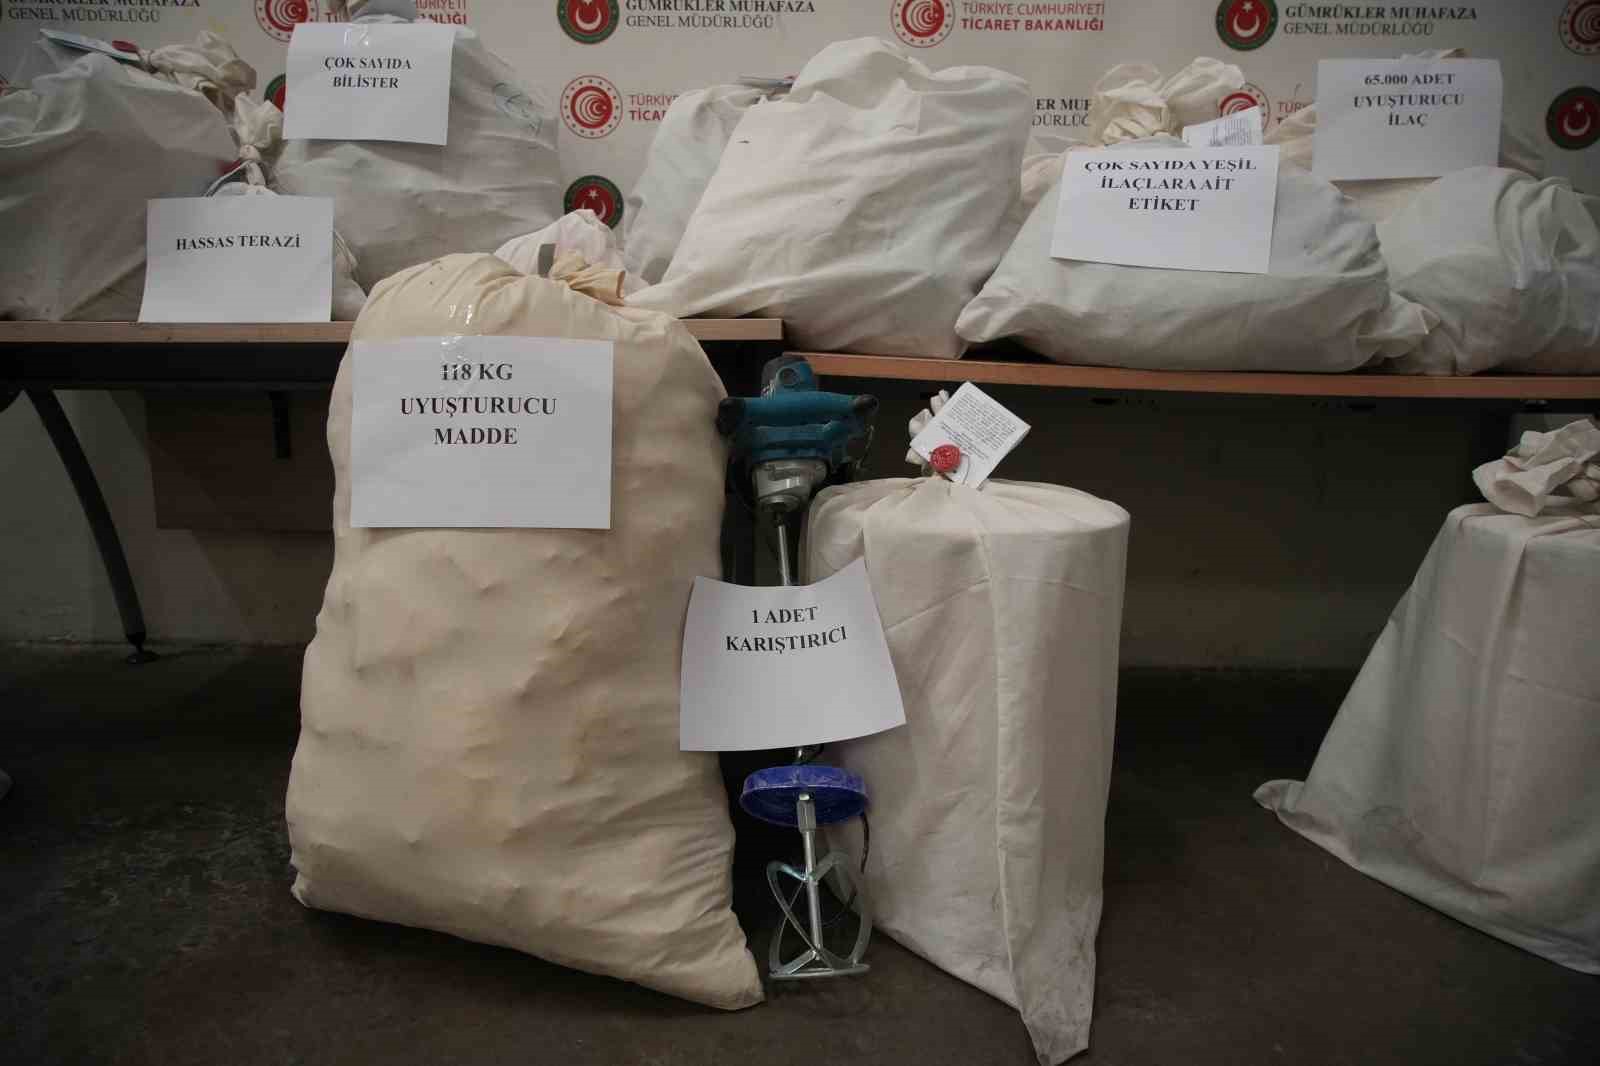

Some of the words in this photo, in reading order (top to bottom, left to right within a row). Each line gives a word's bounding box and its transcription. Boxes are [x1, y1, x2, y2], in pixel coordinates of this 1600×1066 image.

[8, 7, 60, 20] GENEL
[729, 0, 815, 13] MUHAFAZA
[1285, 5, 1385, 19] GÜMRÜKLER
[1389, 7, 1478, 20] MUHAFAZA
[625, 15, 674, 27] GENEL
[678, 14, 774, 28] MÜDÜRLÜĞÜ
[961, 17, 1019, 31] TİCARET
[1025, 17, 1104, 31] BAKANLIĞI
[1284, 22, 1332, 35] GENEL
[324, 57, 355, 70] ÇOK
[359, 58, 412, 70] SAYIDA
[332, 75, 399, 89] BİLİSTER
[1364, 75, 1408, 85] 65.000
[1411, 74, 1455, 85] ADET
[1353, 94, 1464, 108] UYUŞTURUCU
[1388, 113, 1428, 127] İLAÇ
[1085, 161, 1123, 172] ÇOK
[1128, 160, 1197, 171] SAYIDA
[1201, 157, 1257, 172] YEŞİL
[1100, 176, 1197, 191] İLAÇLARA
[1200, 176, 1235, 191] AİT
[1128, 196, 1200, 211] ETİKET
[176, 236, 234, 250] HASSAS
[239, 233, 300, 248] TERAZİ
[442, 363, 472, 381] 118
[479, 363, 513, 381] KG
[400, 396, 557, 418] UYUŞTURUCU
[434, 427, 518, 445] MADDE
[751, 609, 759, 624] 1
[764, 606, 817, 624] ADET
[726, 626, 847, 654] KARIŞTIRICI
